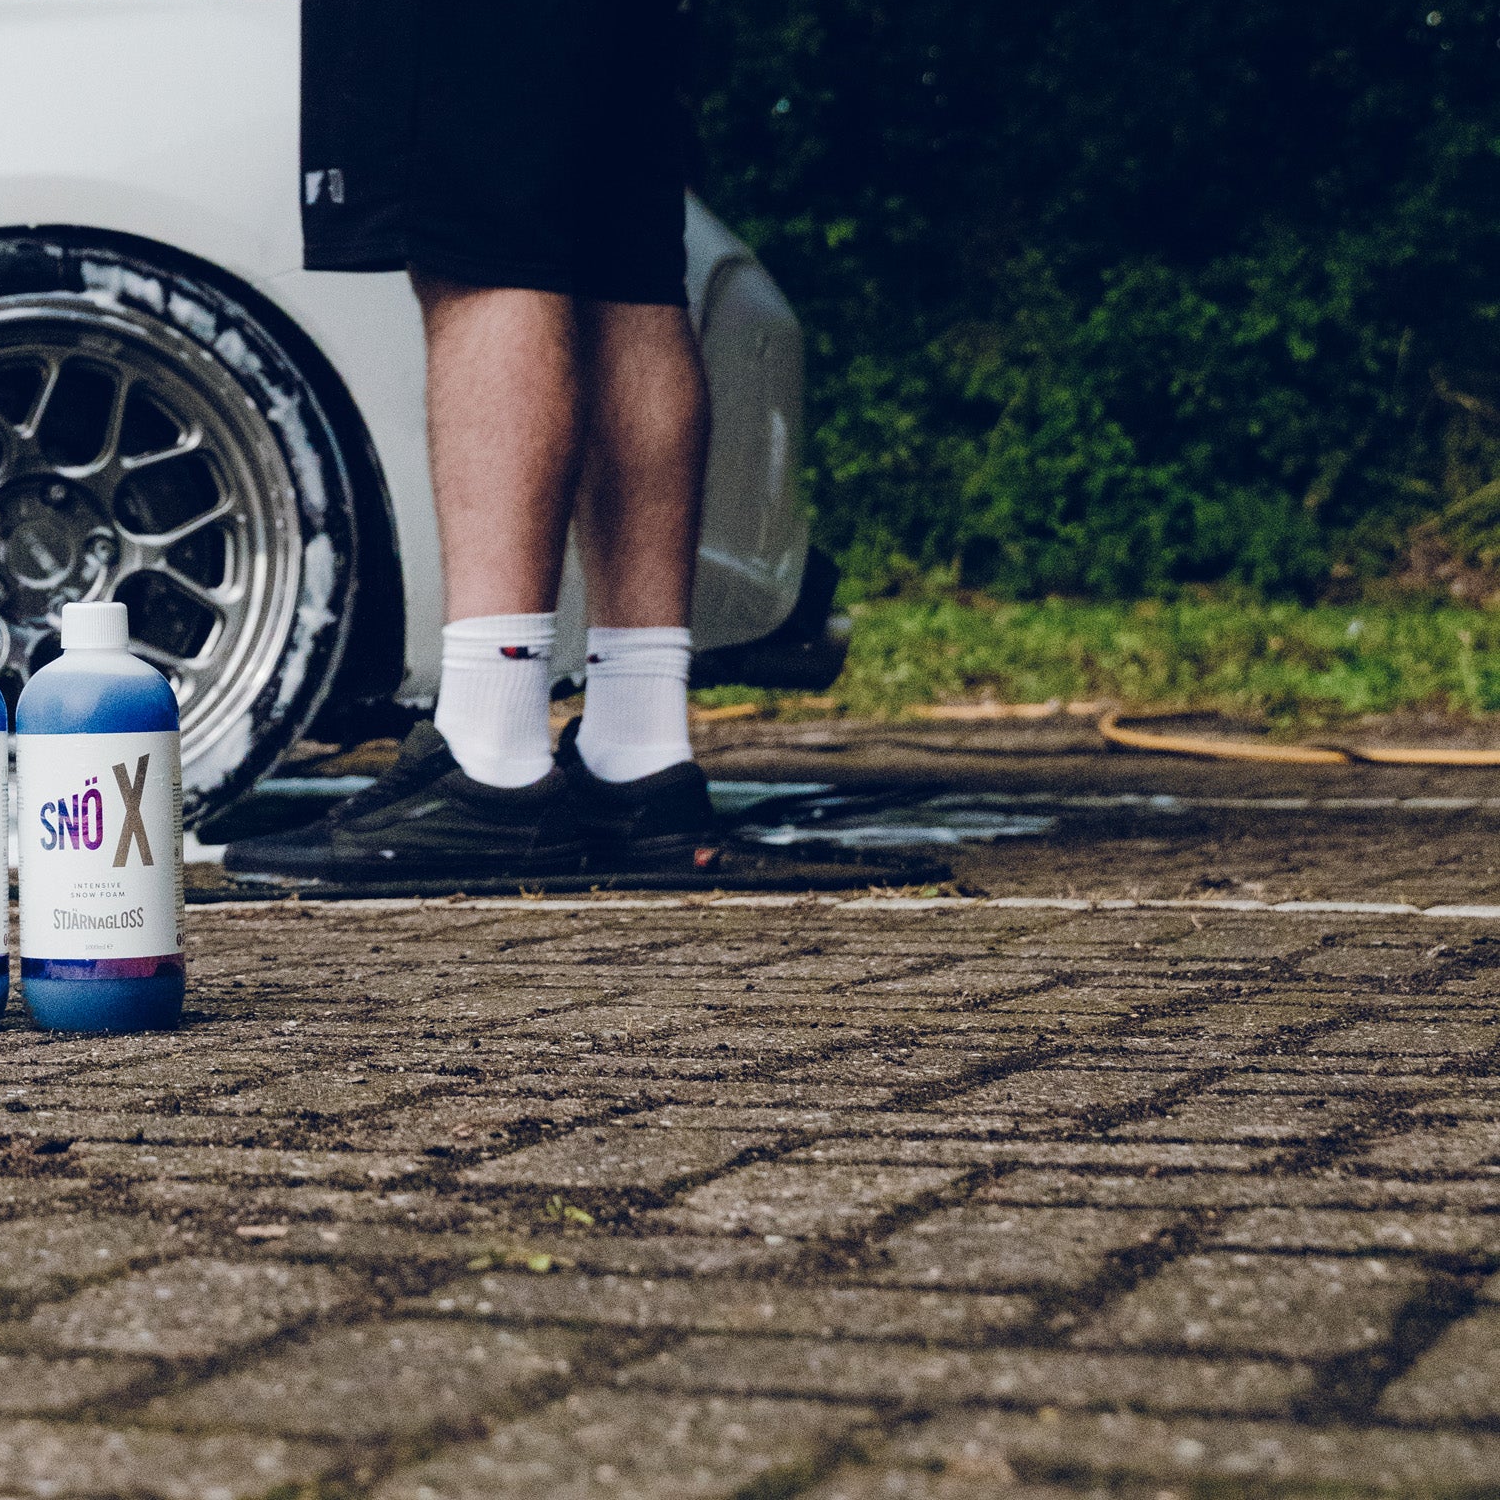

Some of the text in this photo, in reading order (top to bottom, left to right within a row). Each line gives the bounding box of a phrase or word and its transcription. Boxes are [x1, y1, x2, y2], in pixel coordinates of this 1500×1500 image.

[40, 776, 104, 851] SNÖ
[112, 753, 154, 868] X
[53, 907, 144, 930] STJÄRNAGLOSS
